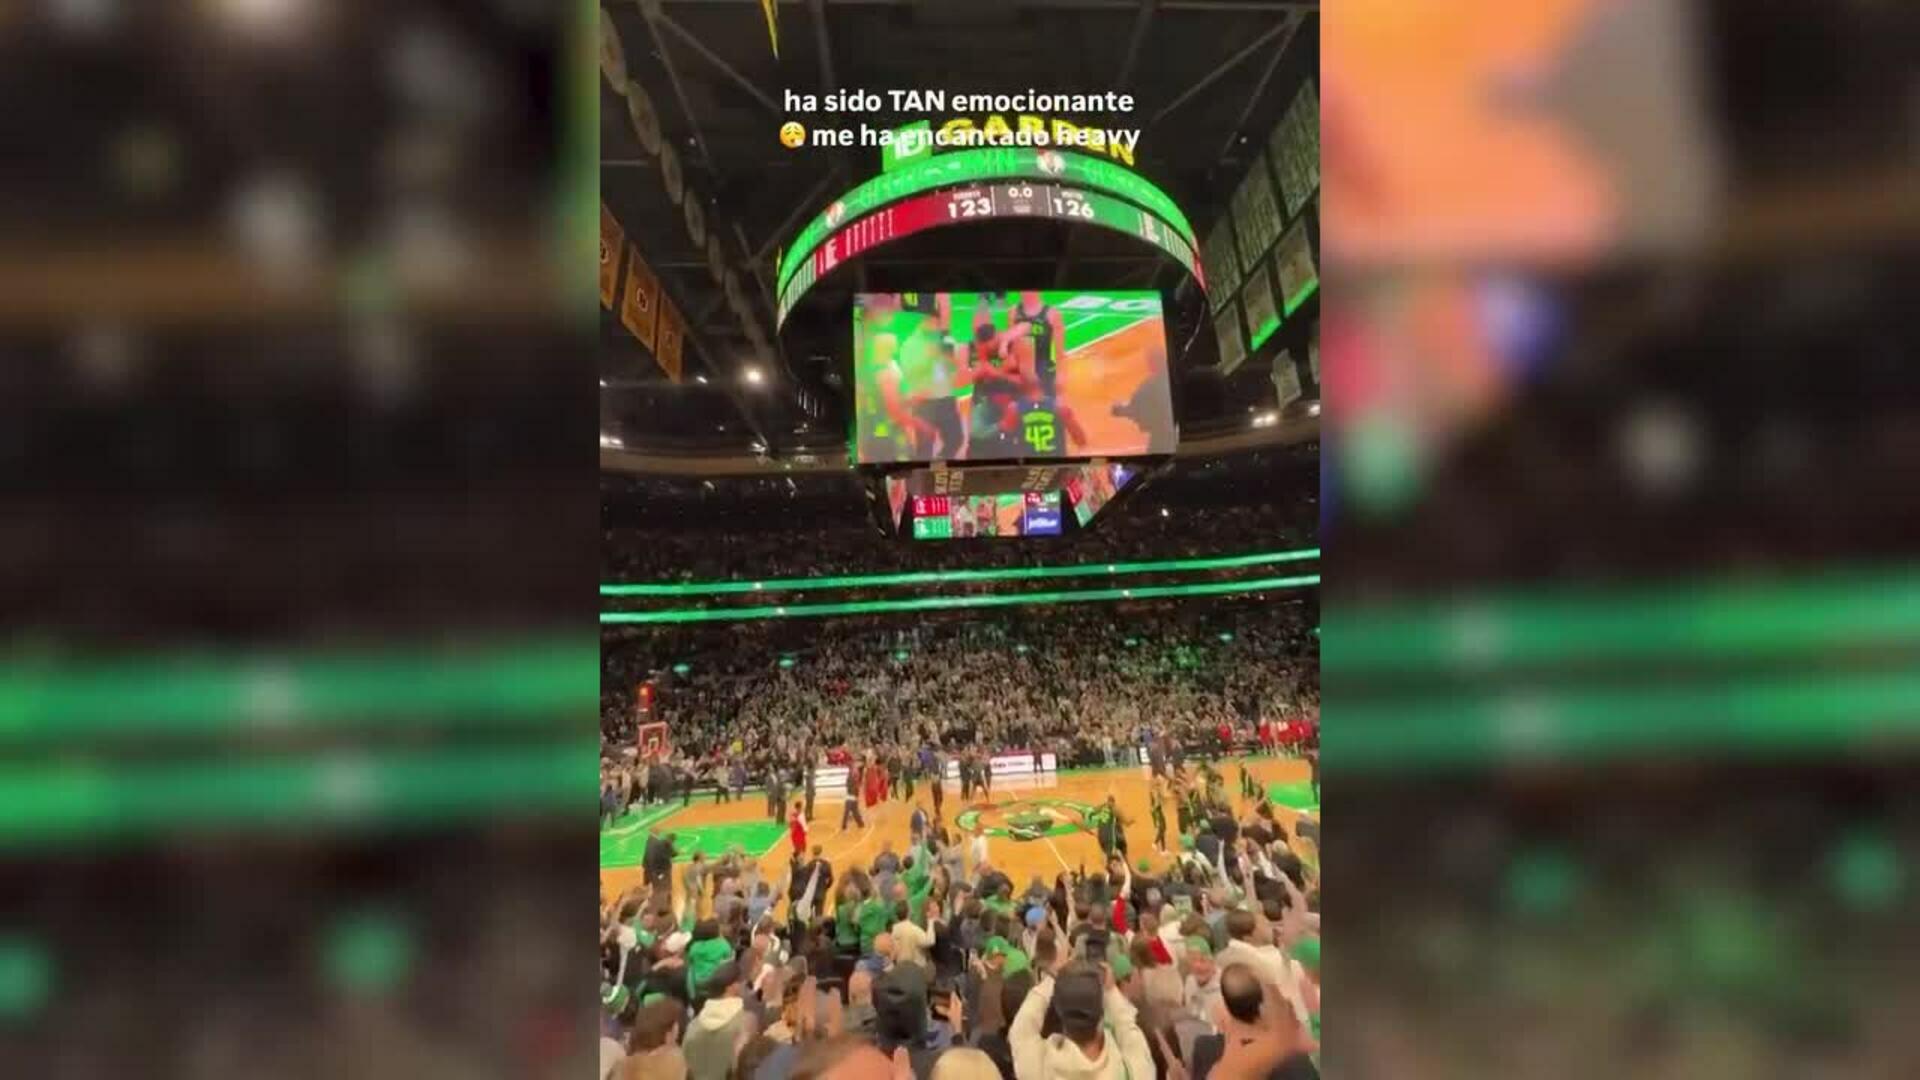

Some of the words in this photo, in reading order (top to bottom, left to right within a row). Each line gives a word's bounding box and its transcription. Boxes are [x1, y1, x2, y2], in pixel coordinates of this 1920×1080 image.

[1007, 186, 1033, 199] 0.0
[947, 197, 992, 219] 123
[1053, 197, 1095, 219] 126
[1024, 425, 1056, 452] 42
